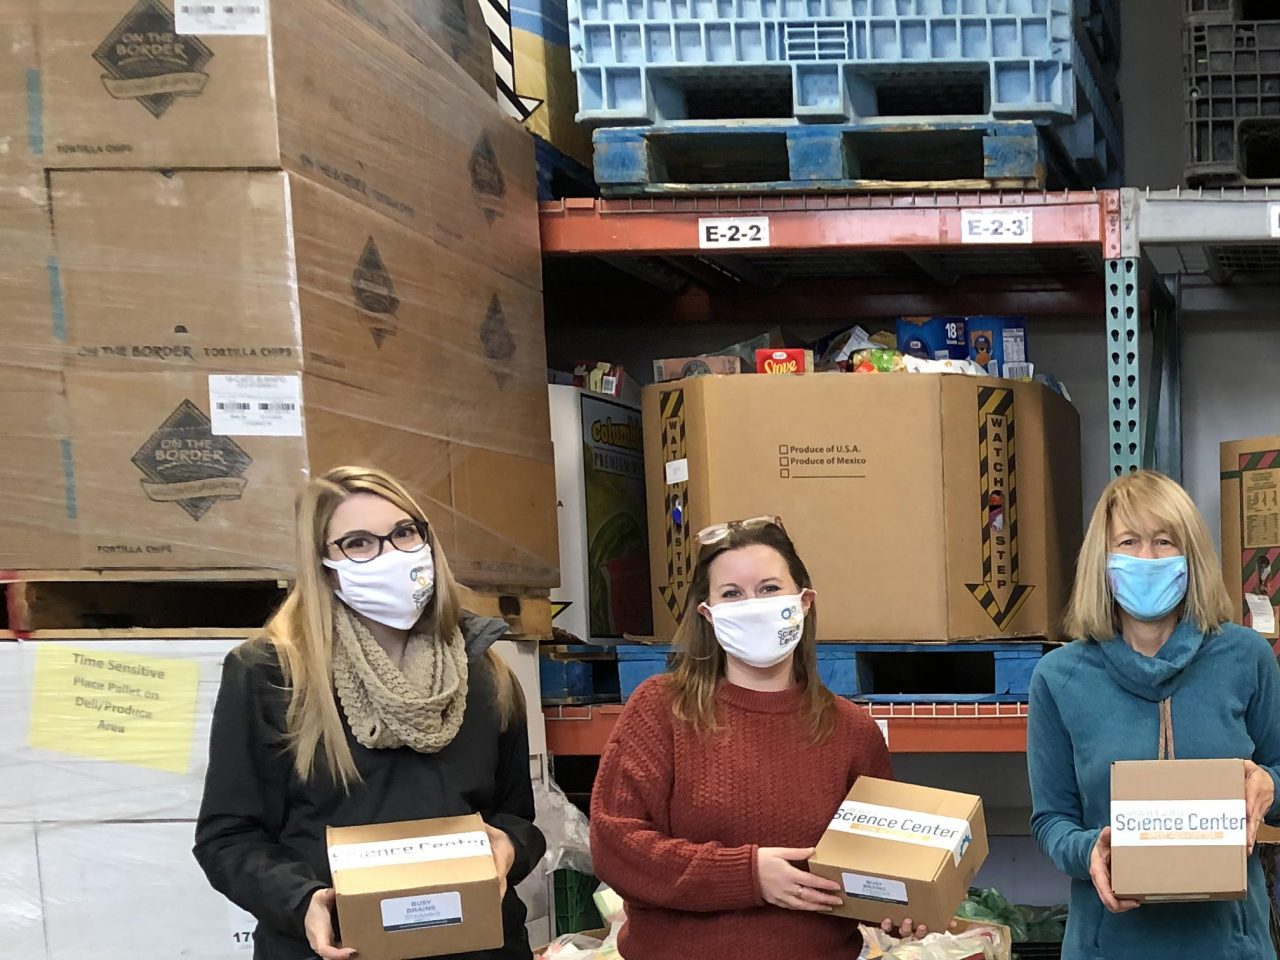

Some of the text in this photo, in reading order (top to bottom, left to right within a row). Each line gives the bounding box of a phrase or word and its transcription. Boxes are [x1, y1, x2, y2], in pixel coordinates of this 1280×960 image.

[706, 225, 761, 242] E-2-2
[968, 219, 1025, 236] E-2-3
[155, 450, 227, 464] BORDER
[826, 445, 834, 453] of
[837, 445, 861, 453] U.S.A.
[790, 457, 824, 465] Produce
[996, 536, 1007, 589] STEP
[73, 653, 166, 679] Time Sensitive
[73, 676, 104, 690] Place
[833, 808, 958, 838] Science Center
[1116, 813, 1184, 831] Science
[1189, 813, 1246, 831] Center
[406, 905, 436, 913] BRAINS
